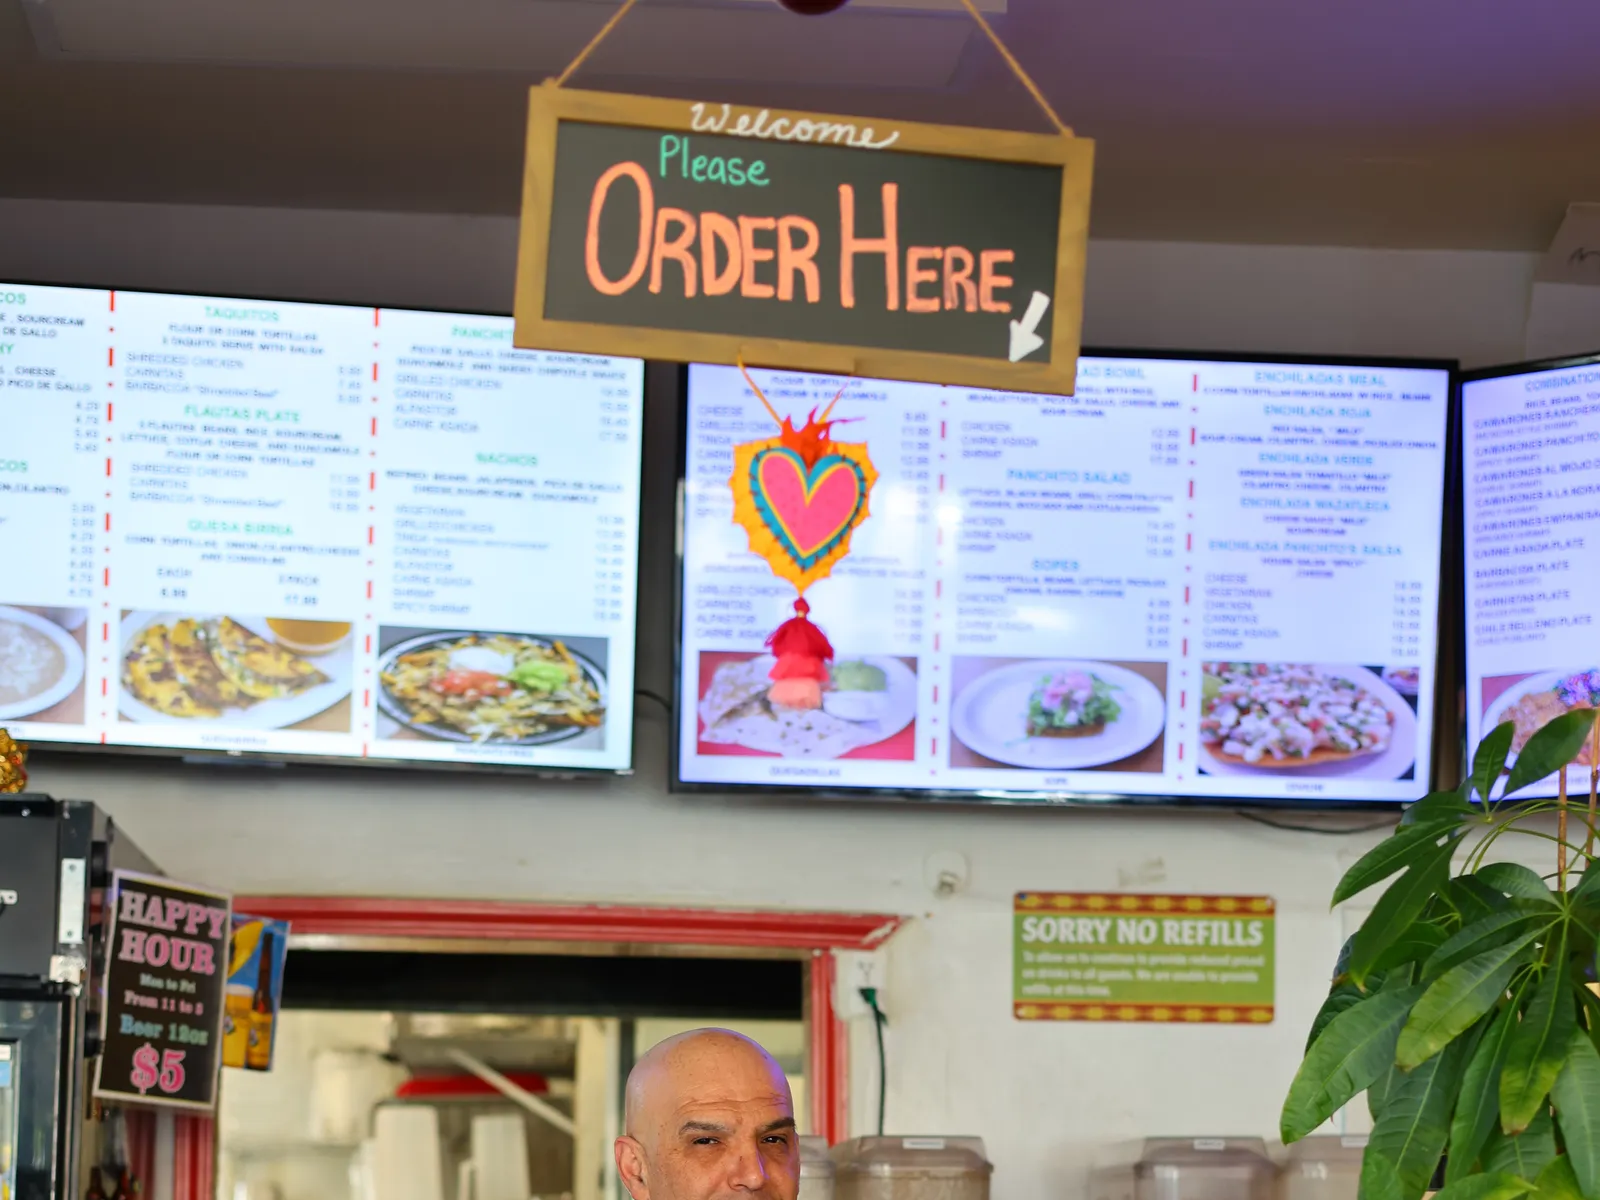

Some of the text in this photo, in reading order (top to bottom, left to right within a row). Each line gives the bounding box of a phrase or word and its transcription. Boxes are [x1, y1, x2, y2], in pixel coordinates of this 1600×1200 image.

[691, 102, 898, 149] Welcome
[659, 134, 770, 186] Please
[585, 161, 1015, 314] ORDER HERE
[119, 890, 227, 939] HAPPY
[1022, 916, 1263, 946] SORRY NO REFILLS
[118, 928, 215, 975] HOUR
[124, 990, 158, 1009] From
[162, 997, 175, 1012] 11
[179, 998, 193, 1013] to
[120, 1013, 163, 1038] Beer
[130, 1042, 186, 1095] $5
